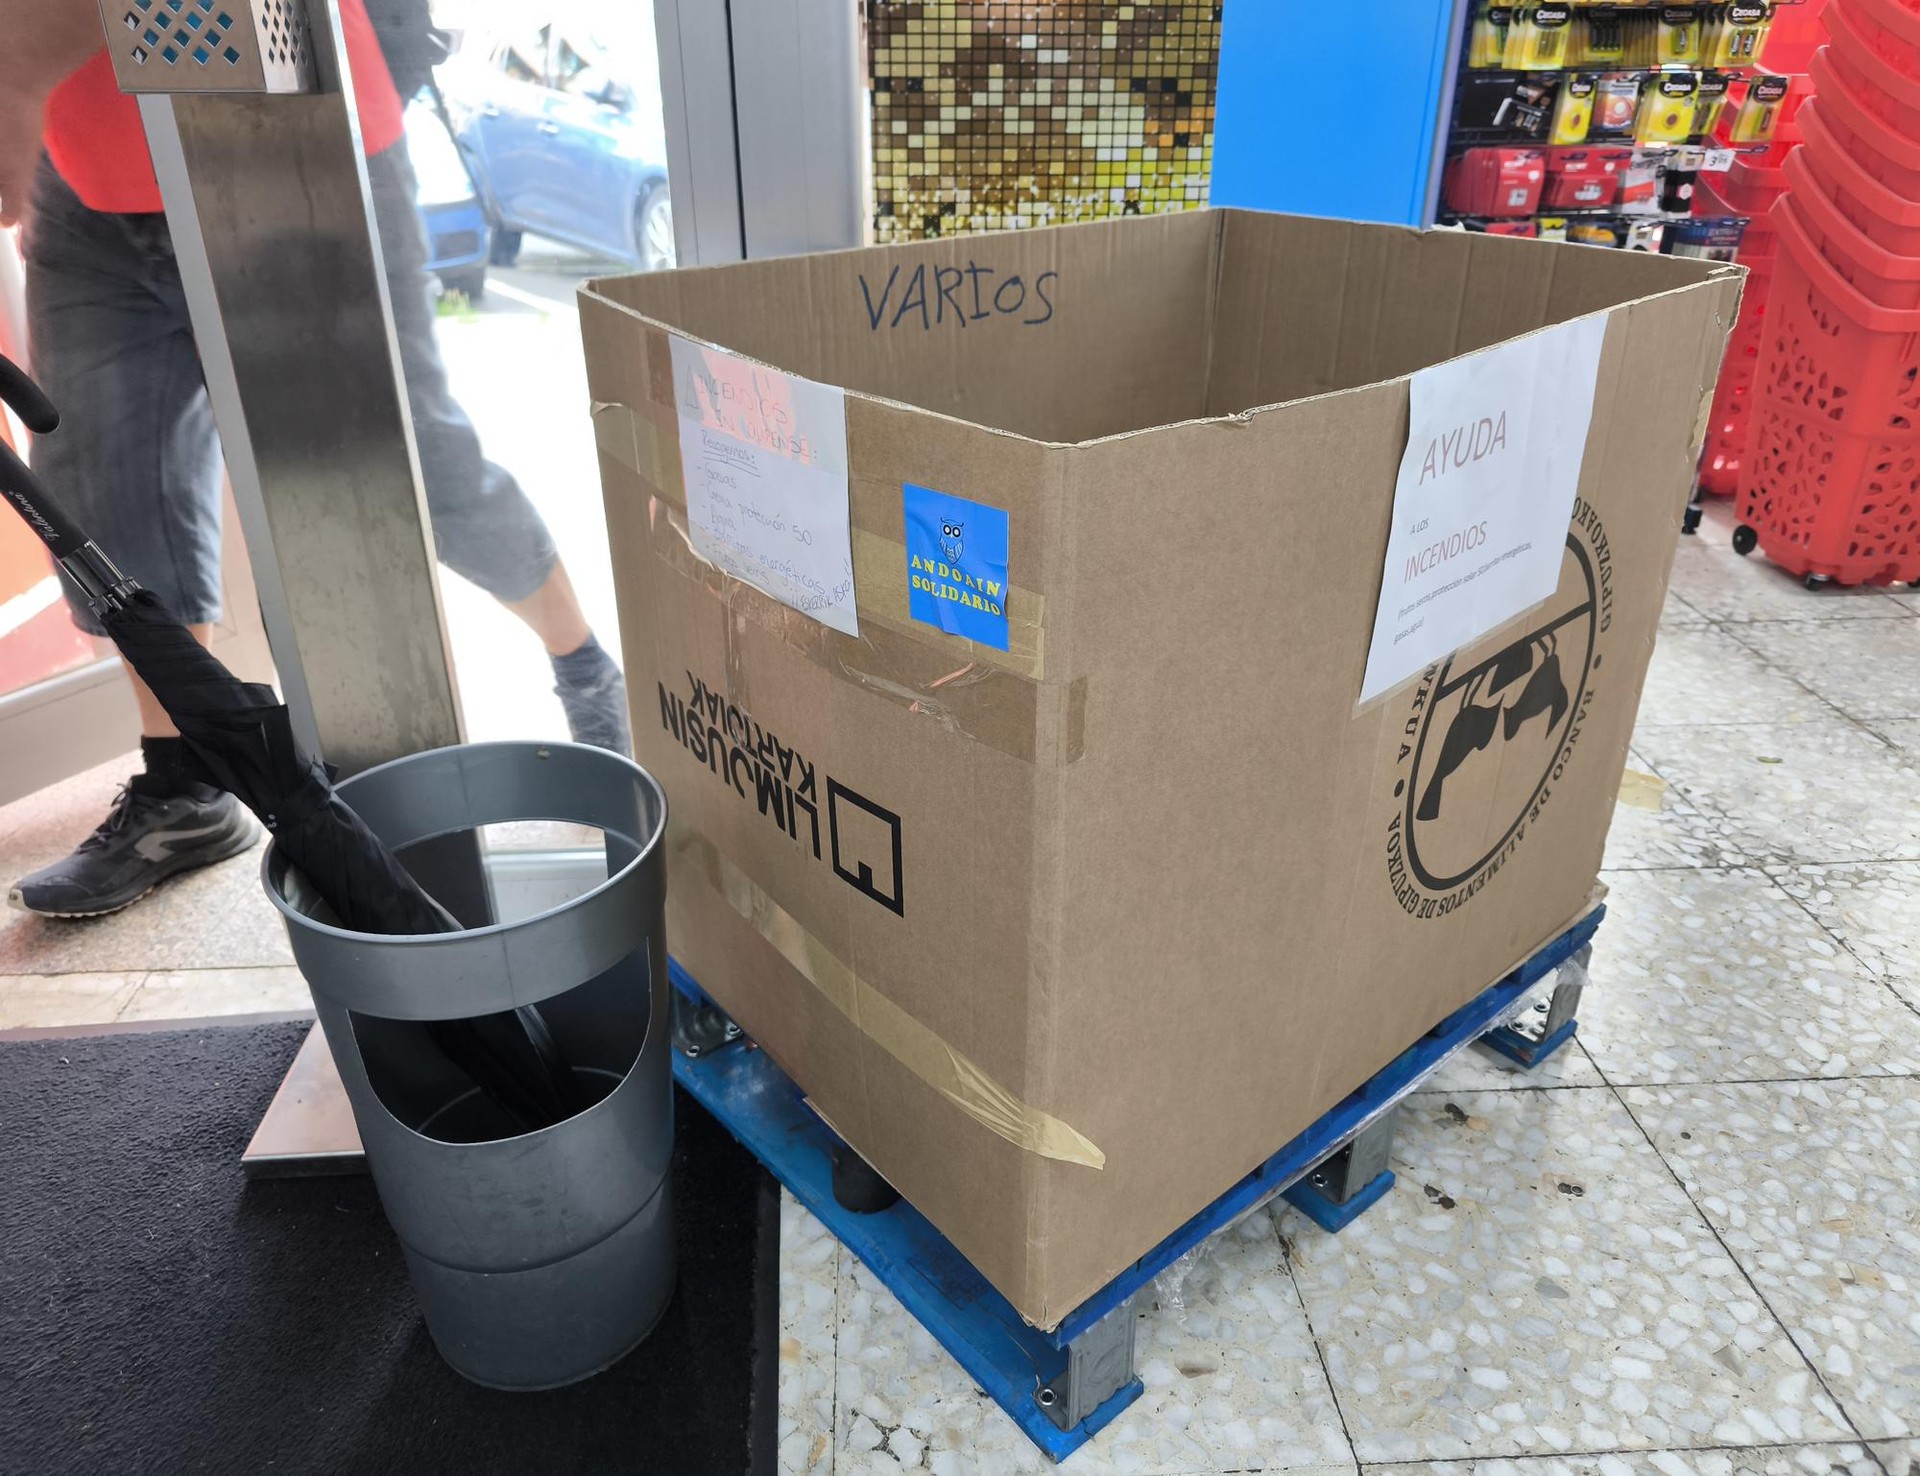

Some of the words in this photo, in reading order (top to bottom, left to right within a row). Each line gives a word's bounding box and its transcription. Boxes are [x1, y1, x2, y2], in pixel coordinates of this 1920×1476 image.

[859, 260, 1058, 331] VARIOS
[1418, 410, 1506, 486] AYUDA
[792, 525, 813, 546] 50
[1403, 520, 1487, 584] INCENDIOS
[1416, 518, 1429, 533] LOS
[911, 554, 1001, 598] ANDOAIN
[911, 574, 1001, 617] SOLIDARIO
[686, 669, 818, 805] KARTOIAK
[1397, 663, 1438, 764] NKUA
[1552, 690, 1594, 781] BANCO
[657, 680, 822, 861] LIMOUSIN
[1529, 787, 1552, 824] DE
[1387, 810, 1421, 915] GIPUZKOA
[1435, 825, 1526, 918] ALIMENTOS
[1416, 898, 1438, 920] DE
